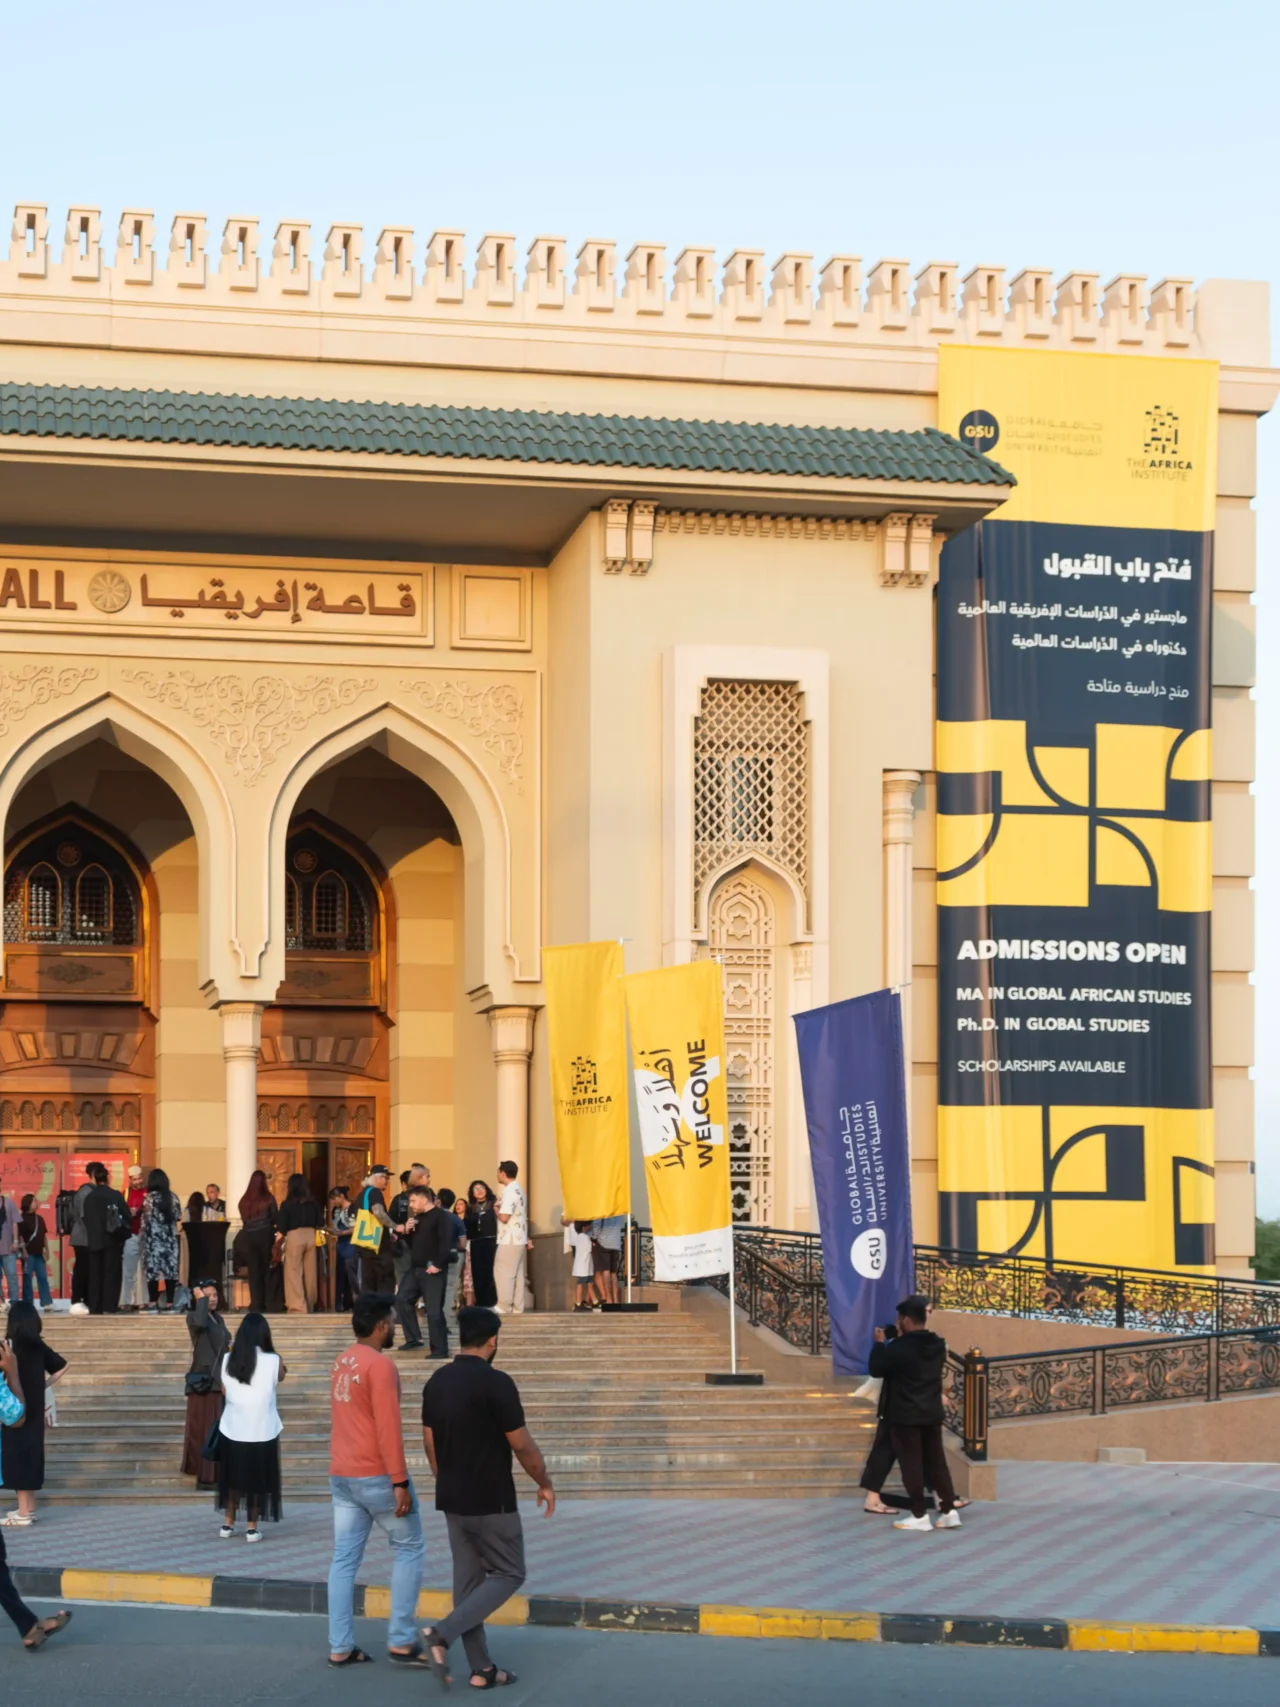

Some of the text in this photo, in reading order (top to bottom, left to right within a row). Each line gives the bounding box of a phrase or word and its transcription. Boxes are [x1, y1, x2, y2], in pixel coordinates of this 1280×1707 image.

[965, 424, 995, 439] GSU
[1149, 459, 1193, 470] AFRICA
[1131, 469, 1190, 482] INSTITUTE
[1043, 552, 1193, 583] فتح باب القبول
[140, 573, 417, 624] قاعة إفريقيا
[957, 600, 1006, 617] العالمية
[1009, 602, 1062, 621] الإفريقية
[1120, 607, 1141, 627] في
[1144, 608, 1188, 625] ماجستير
[1011, 633, 1058, 650] العالمية
[1122, 640, 1143, 659] في
[1145, 639, 1187, 656] دكتوراه
[1086, 677, 1189, 701] منح دراسية متاحة
[957, 939, 1187, 965] ADMISSIONS OPEN
[956, 987, 1192, 1005] MA IN GLOBAL AFRICAN STUDIES
[957, 1017, 1150, 1033] Ph.D. IN GLOBAL STUDIES
[957, 1059, 1126, 1074] SCHOLARSHIPS AVAILABLE
[576, 1095, 612, 1106] AFRICA
[687, 1039, 713, 1169] WELCOME
[564, 1104, 609, 1116] INSTITUTE
[851, 1103, 868, 1158] STUDIES
[872, 1146, 888, 1221] UNIVERSITY
[848, 1174, 863, 1225] GLOBAL
[868, 1237, 881, 1270] GSU
